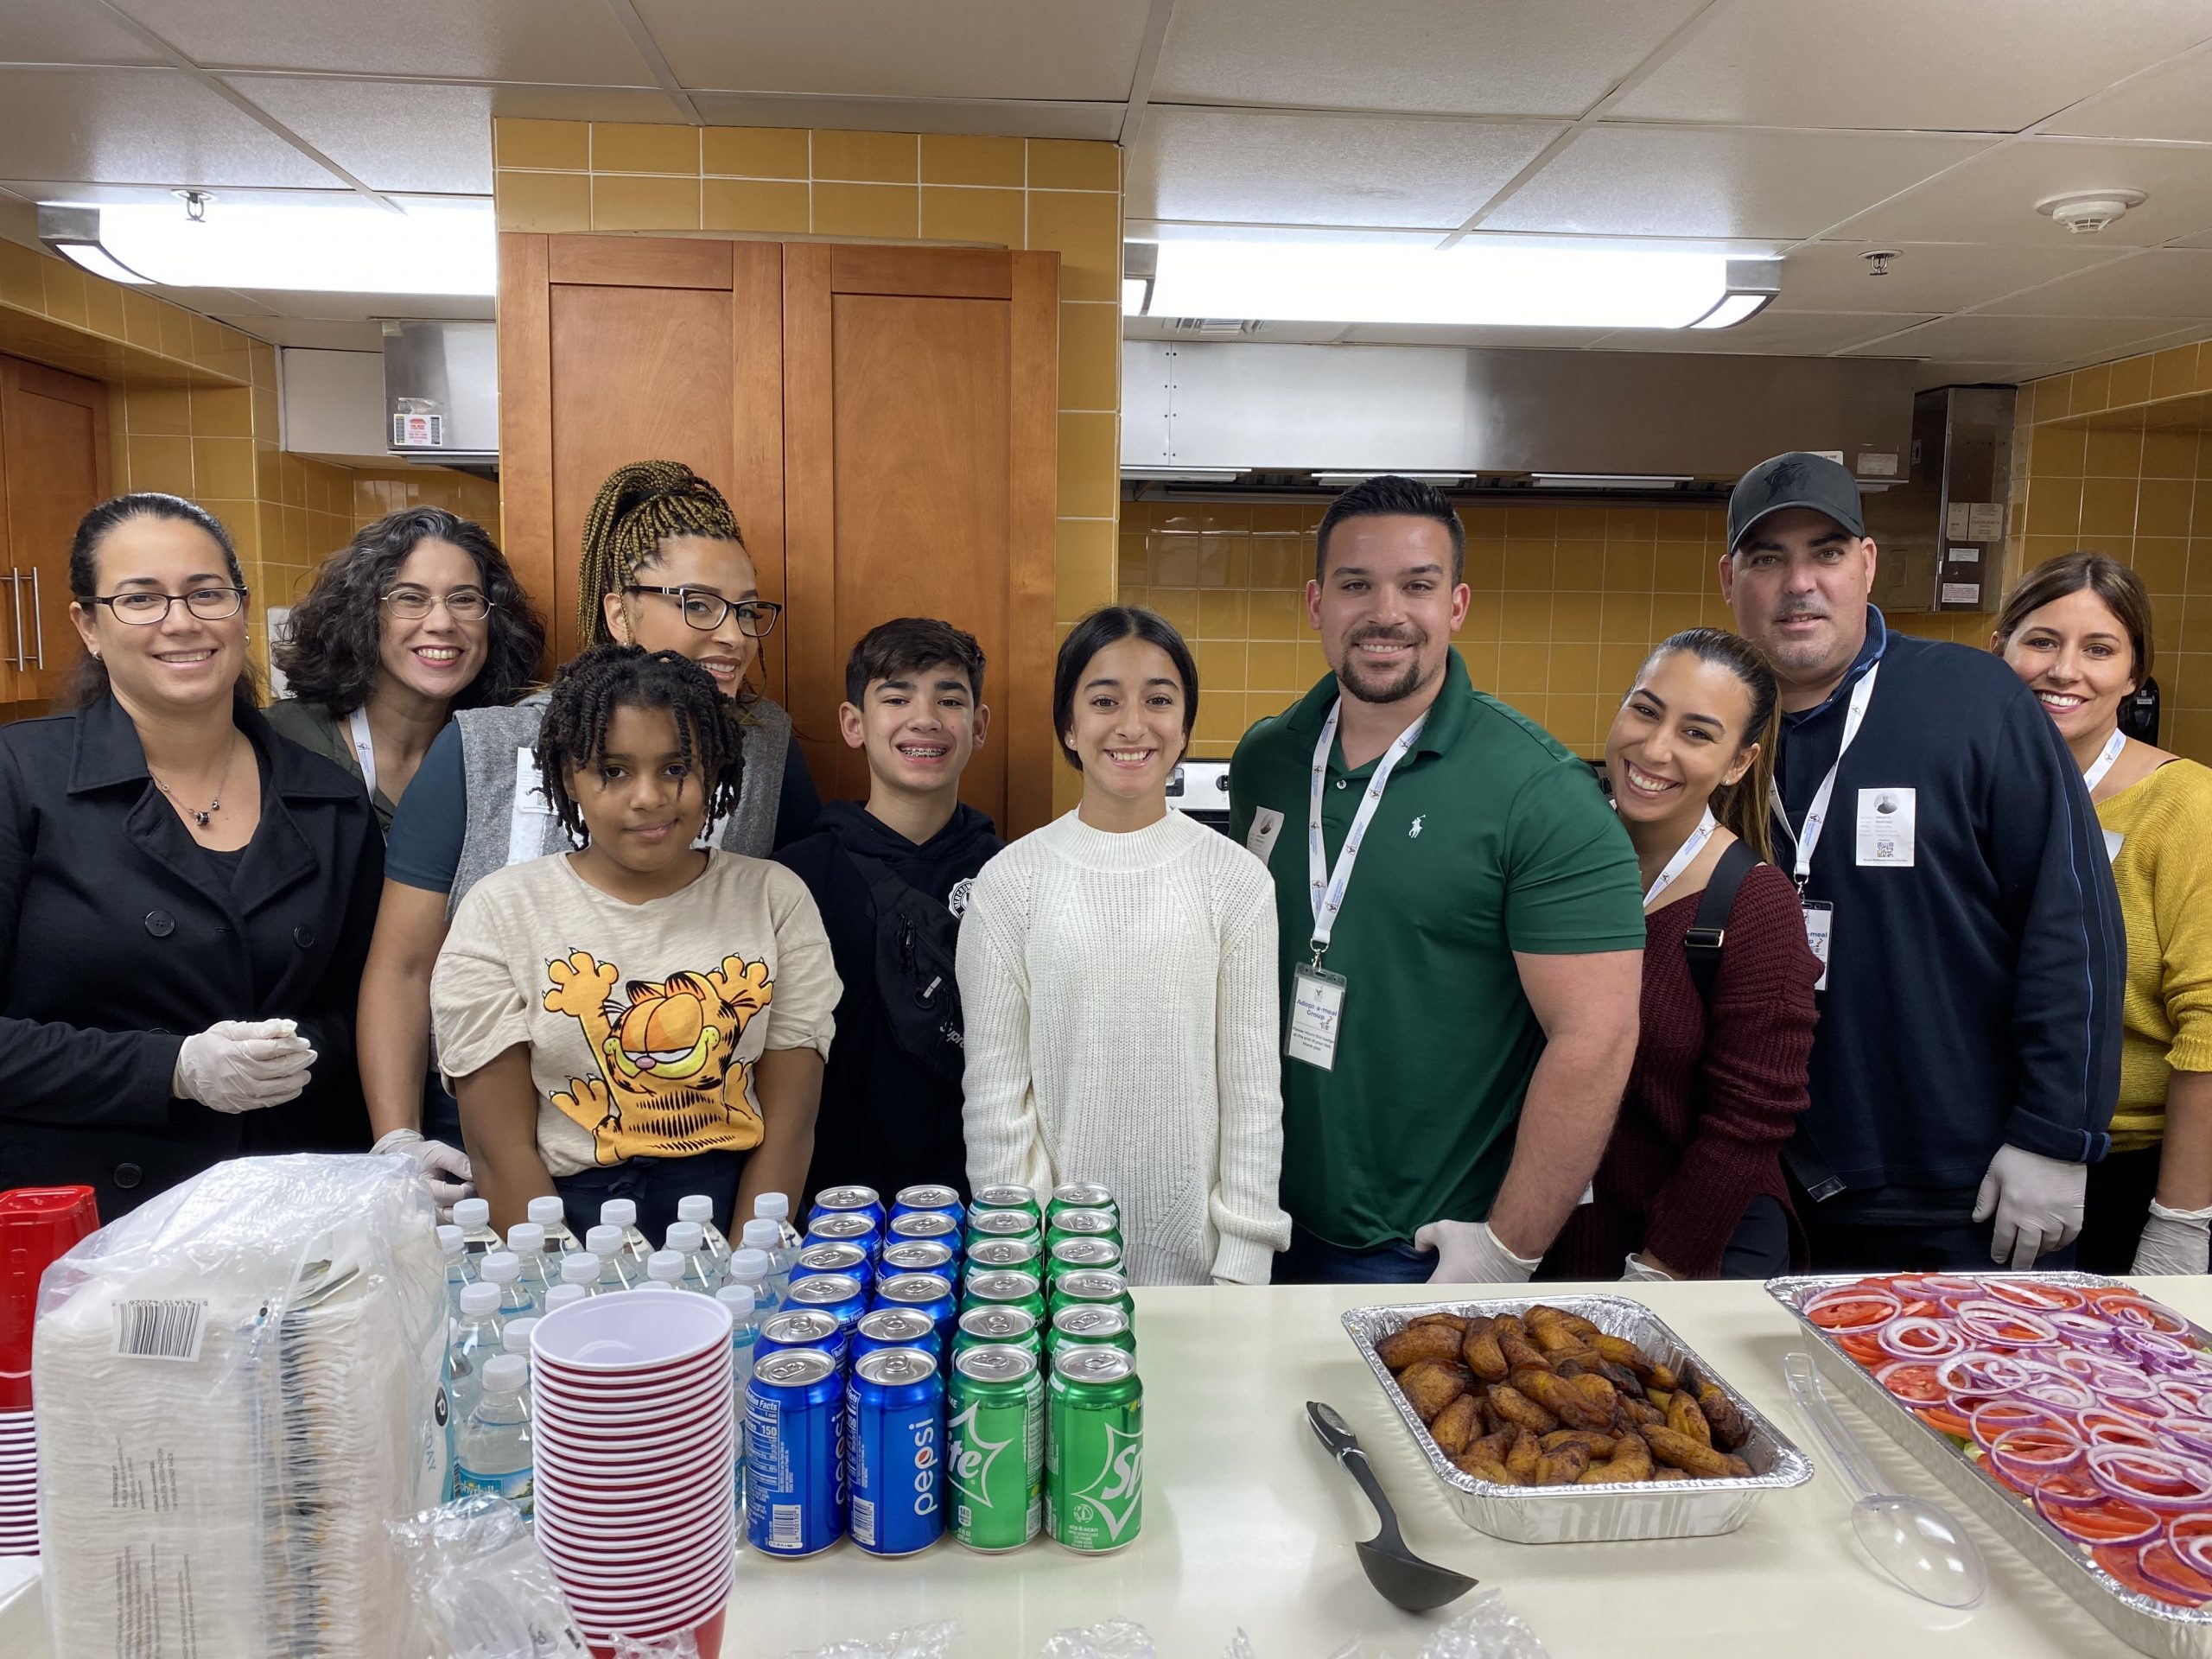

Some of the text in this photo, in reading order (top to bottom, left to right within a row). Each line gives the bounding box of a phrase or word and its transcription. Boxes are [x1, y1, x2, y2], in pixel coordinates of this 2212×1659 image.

[1306, 1009, 1325, 1021] Group
[760, 1398, 779, 1412] Facts
[761, 1425, 777, 1437] 150
[908, 1417, 938, 1516] pepsi
[960, 1507, 970, 1517] 140
